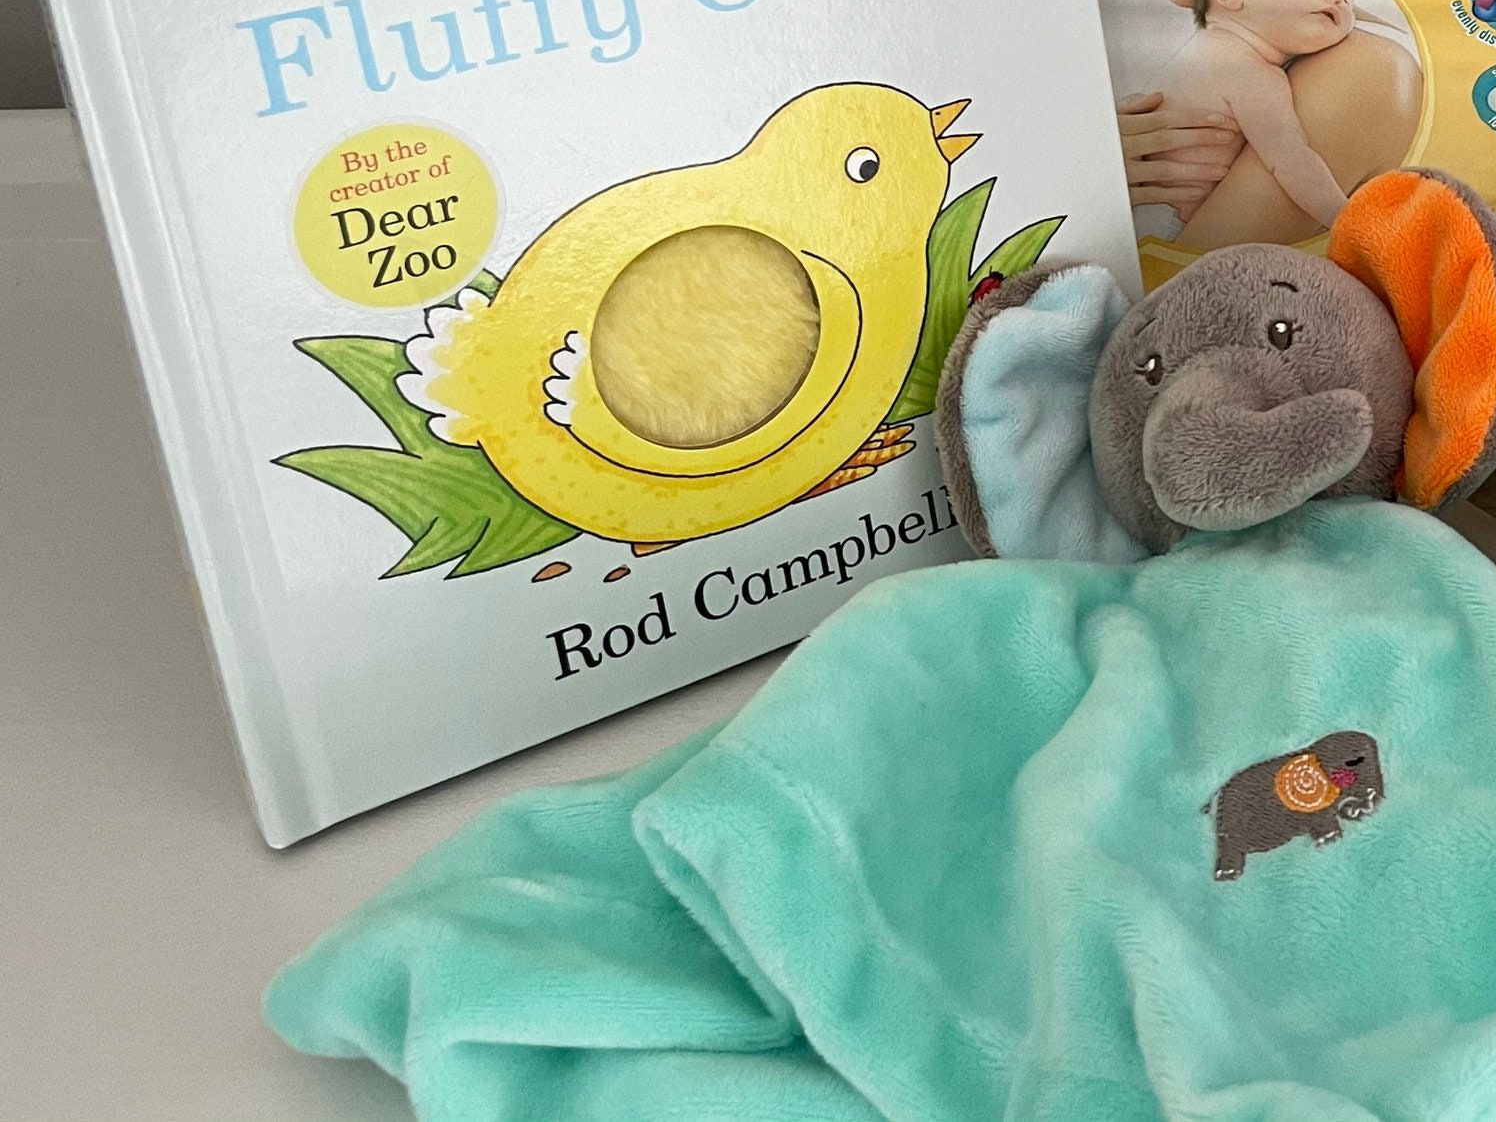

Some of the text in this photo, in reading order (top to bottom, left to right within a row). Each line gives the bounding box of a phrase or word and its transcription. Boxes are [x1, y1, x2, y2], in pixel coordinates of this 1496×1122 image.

[1452, 0, 1479, 35] evenly
[329, 156, 453, 205] creator of
[341, 136, 429, 178] By the
[331, 188, 459, 250] Dear
[367, 244, 459, 291] Zoo
[546, 591, 677, 681] Rod
